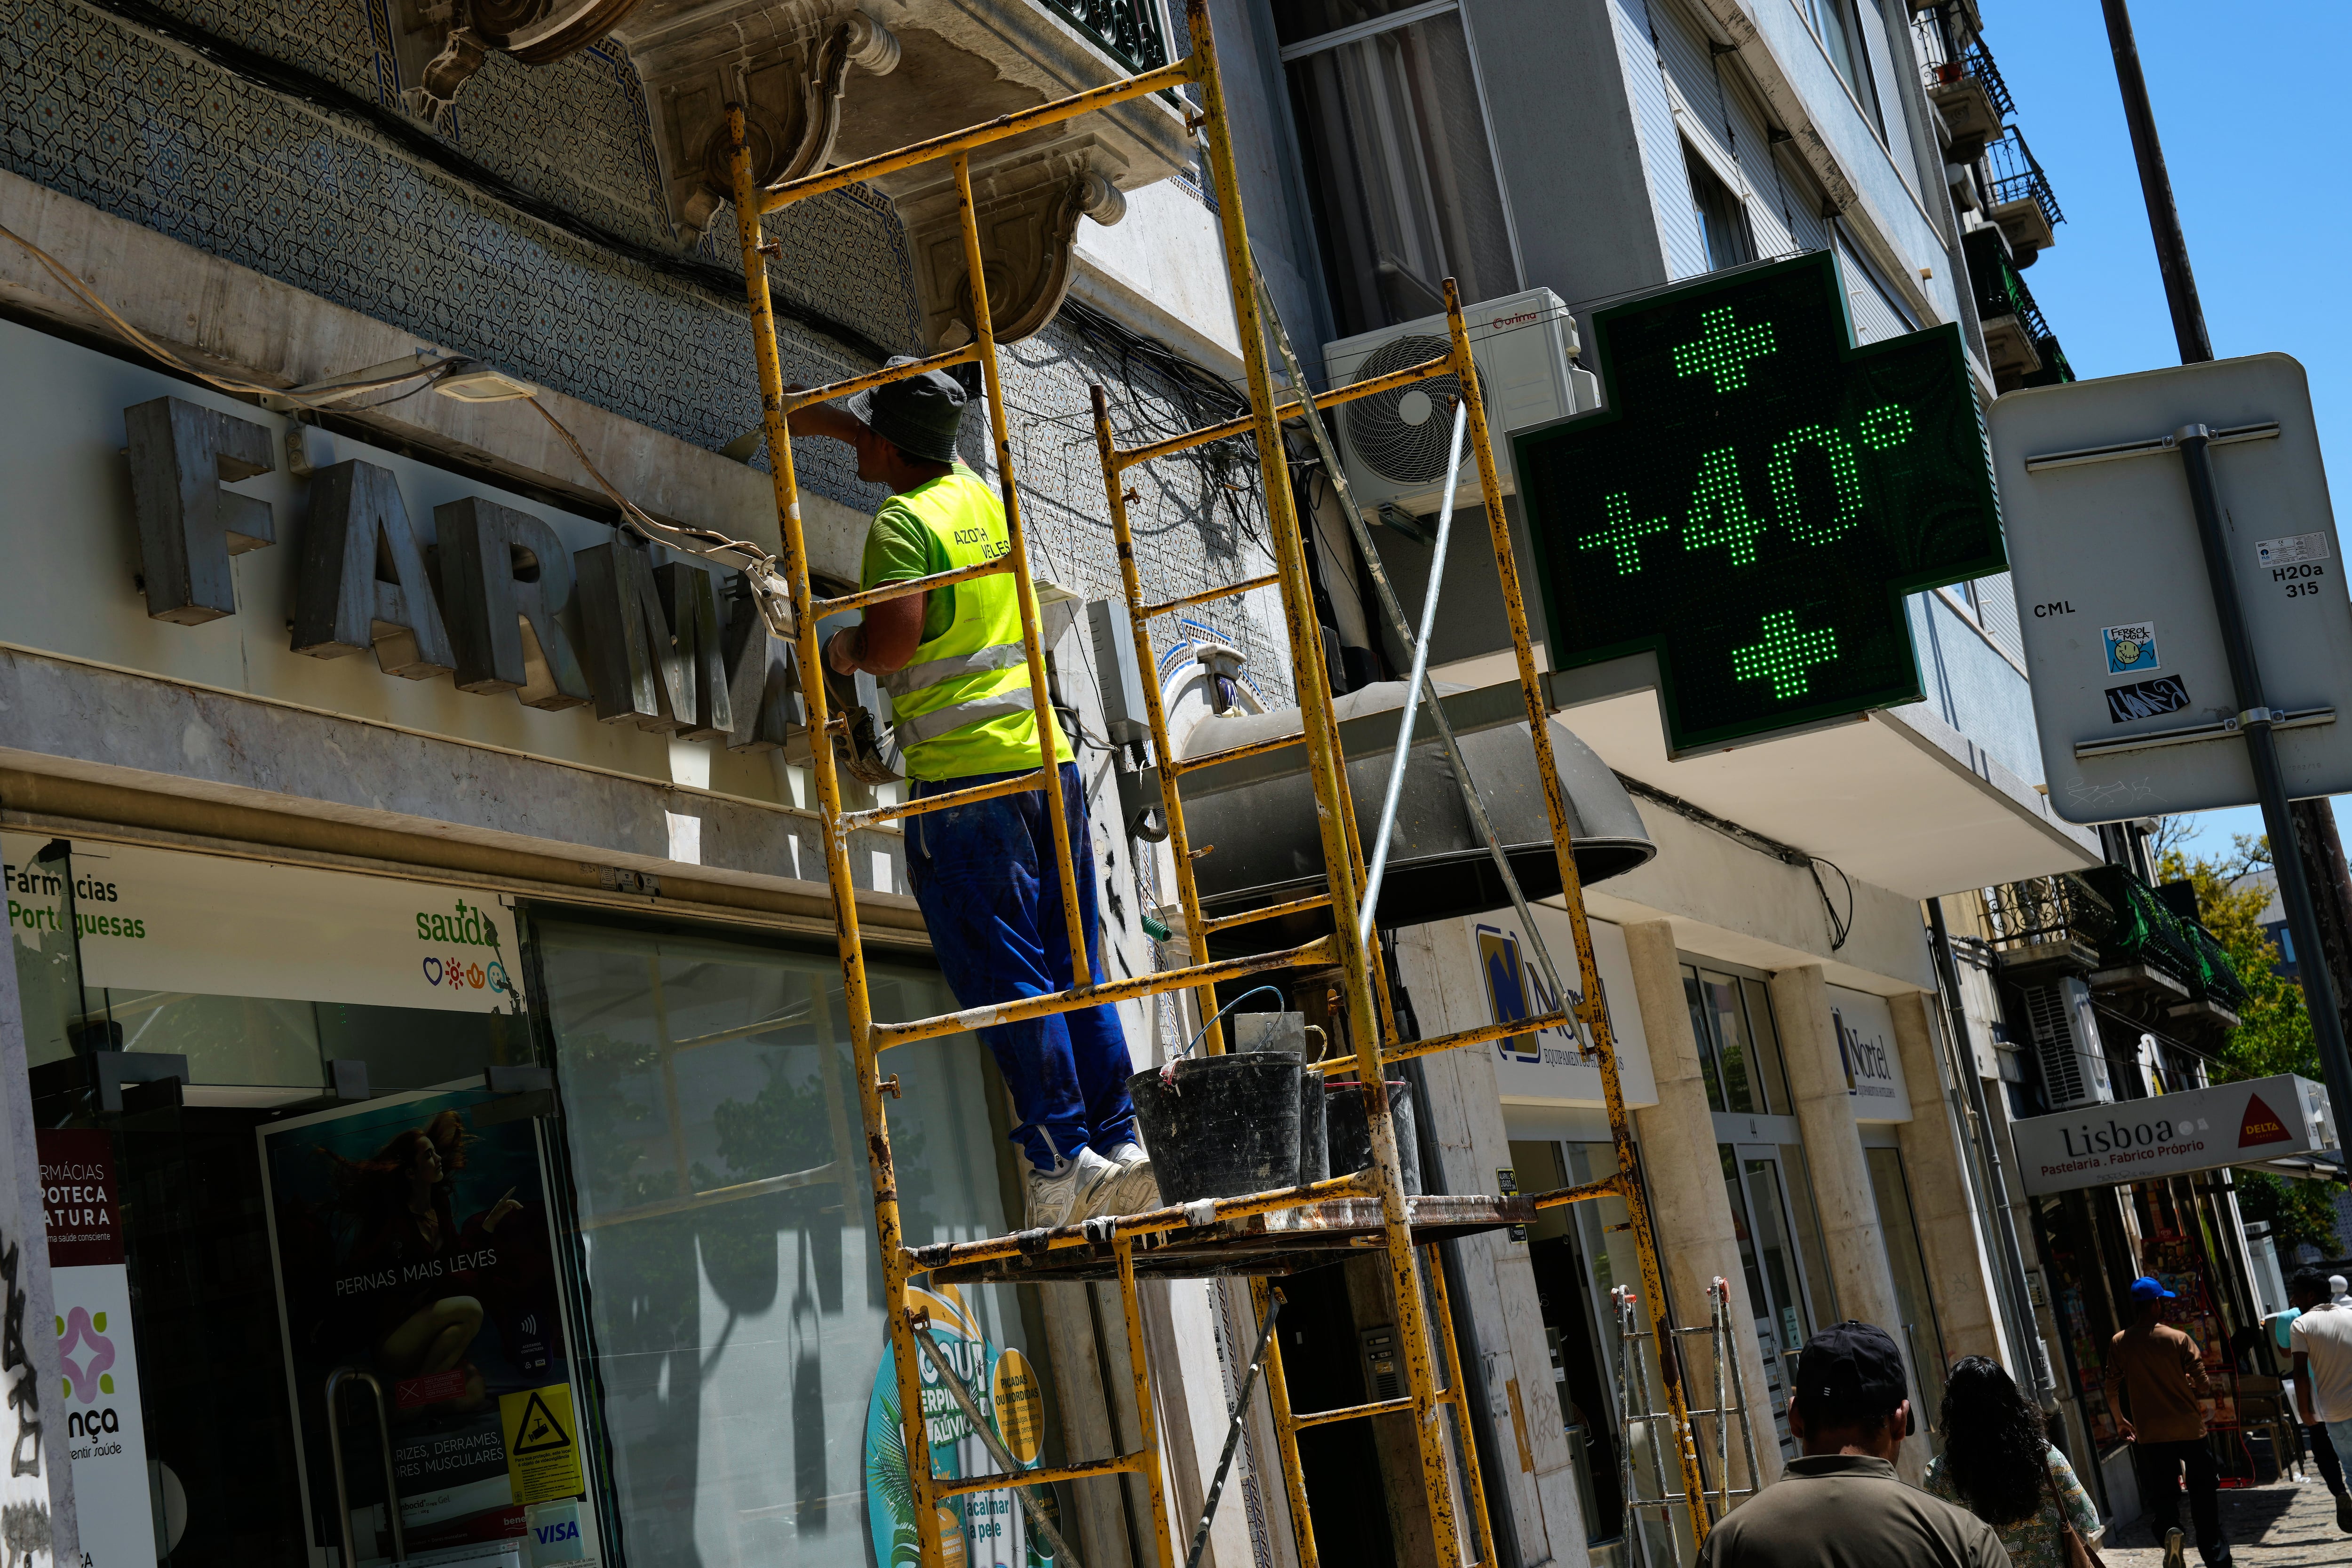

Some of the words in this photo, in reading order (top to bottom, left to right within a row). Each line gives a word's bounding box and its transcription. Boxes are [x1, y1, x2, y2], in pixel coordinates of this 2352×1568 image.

[2285, 581, 2319, 598] 315
[2034, 601, 2076, 618] CML
[2111, 626, 2151, 637] FERROL
[8, 899, 145, 939] Portguesas
[1844, 1027, 1891, 1080] Nortel
[2245, 1122, 2280, 1135] DELTA
[2059, 1120, 2173, 1157] Lisboa
[2041, 1158, 2100, 1176] Pastelaria
[2109, 1149, 2154, 1165] Fabrico
[2157, 1140, 2204, 1157] Próprio
[39, 1160, 104, 1181] RMÁCIAS
[44, 1208, 111, 1227] ATURA
[58, 1233, 77, 1242] saúde
[78, 1232, 111, 1241] consciente
[336, 1269, 397, 1297] PERNAS
[403, 1259, 443, 1283] MAIS
[449, 1249, 497, 1273] LEVES
[432, 1380, 453, 1389] SMOKERS
[434, 1373, 461, 1382] FUMADORES
[1000, 1374, 1028, 1389] PICADAS
[996, 1394, 1005, 1406] OU
[1006, 1387, 1039, 1404] MORDIDAS
[68, 1408, 119, 1444] nça
[70, 1446, 91, 1460] entir
[94, 1441, 122, 1457] saúde
[394, 1444, 429, 1462] RIZES,
[434, 1431, 501, 1455] DERRAMES,
[425, 1447, 505, 1473] MUSCULARES
[540, 1454, 570, 1463] videovigilância
[437, 1495, 451, 1505] Gel
[967, 1497, 1009, 1517] acalmar
[1038, 1497, 1054, 1508] CÁRIA
[444, 1532, 468, 1542] musculares
[532, 1521, 580, 1544] VISA
[969, 1524, 977, 1539] a
[978, 1518, 1001, 1543] pele
